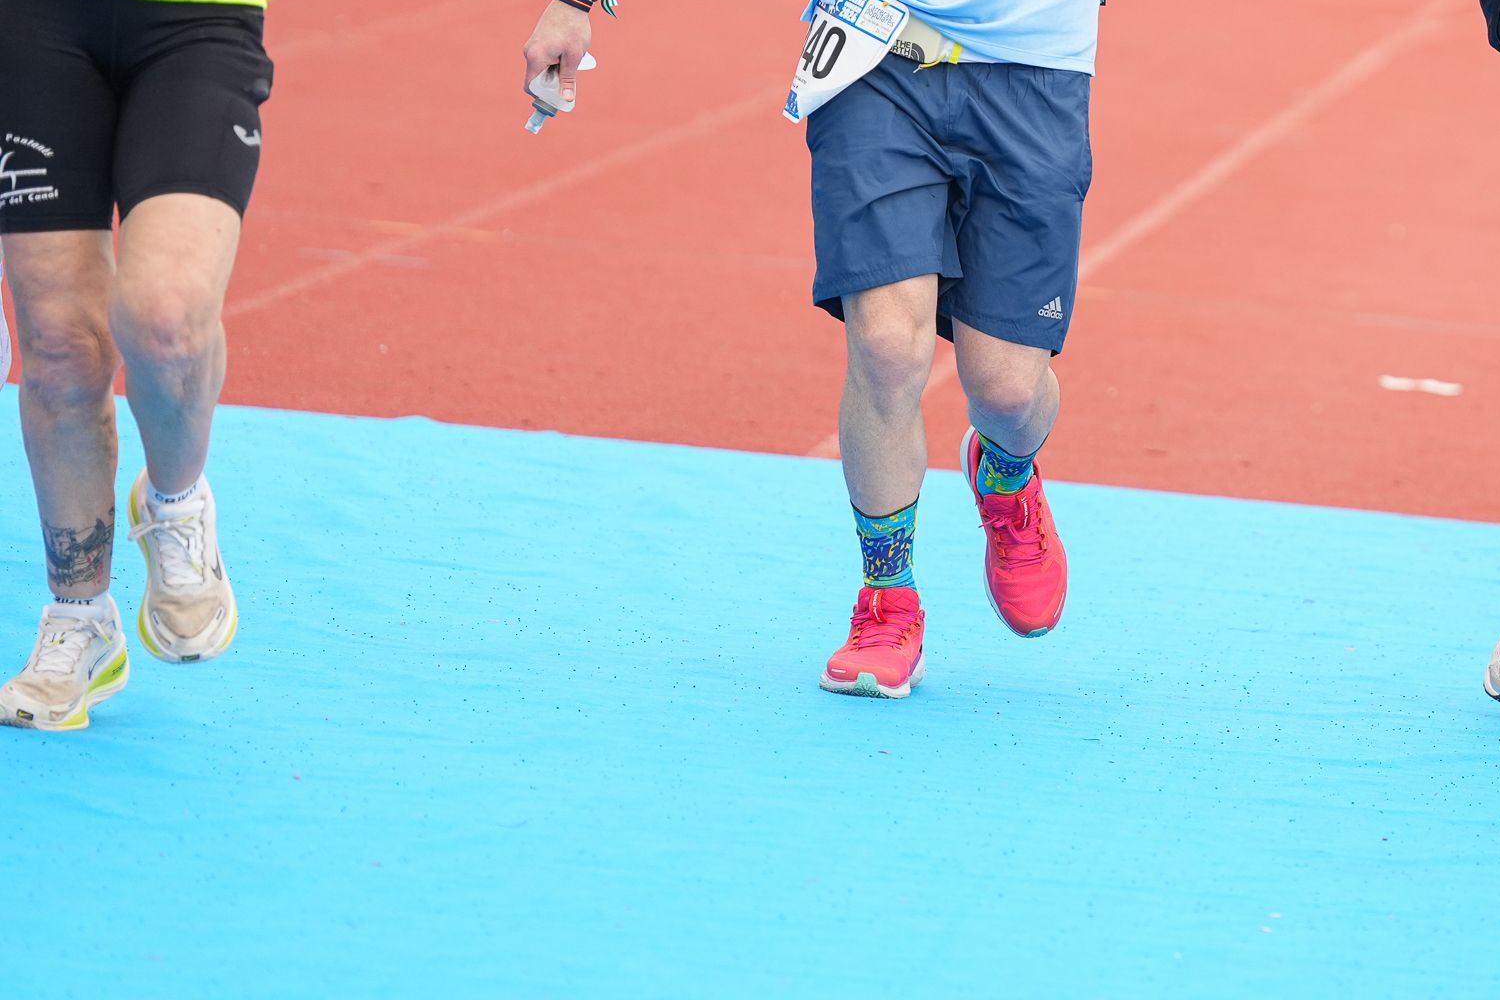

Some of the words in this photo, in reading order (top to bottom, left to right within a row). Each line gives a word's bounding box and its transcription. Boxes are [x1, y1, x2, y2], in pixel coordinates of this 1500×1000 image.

[801, 13, 847, 80] 40
[895, 39, 911, 49] THE
[27, 188, 59, 203] Canal
[1038, 308, 1064, 320] adidas
